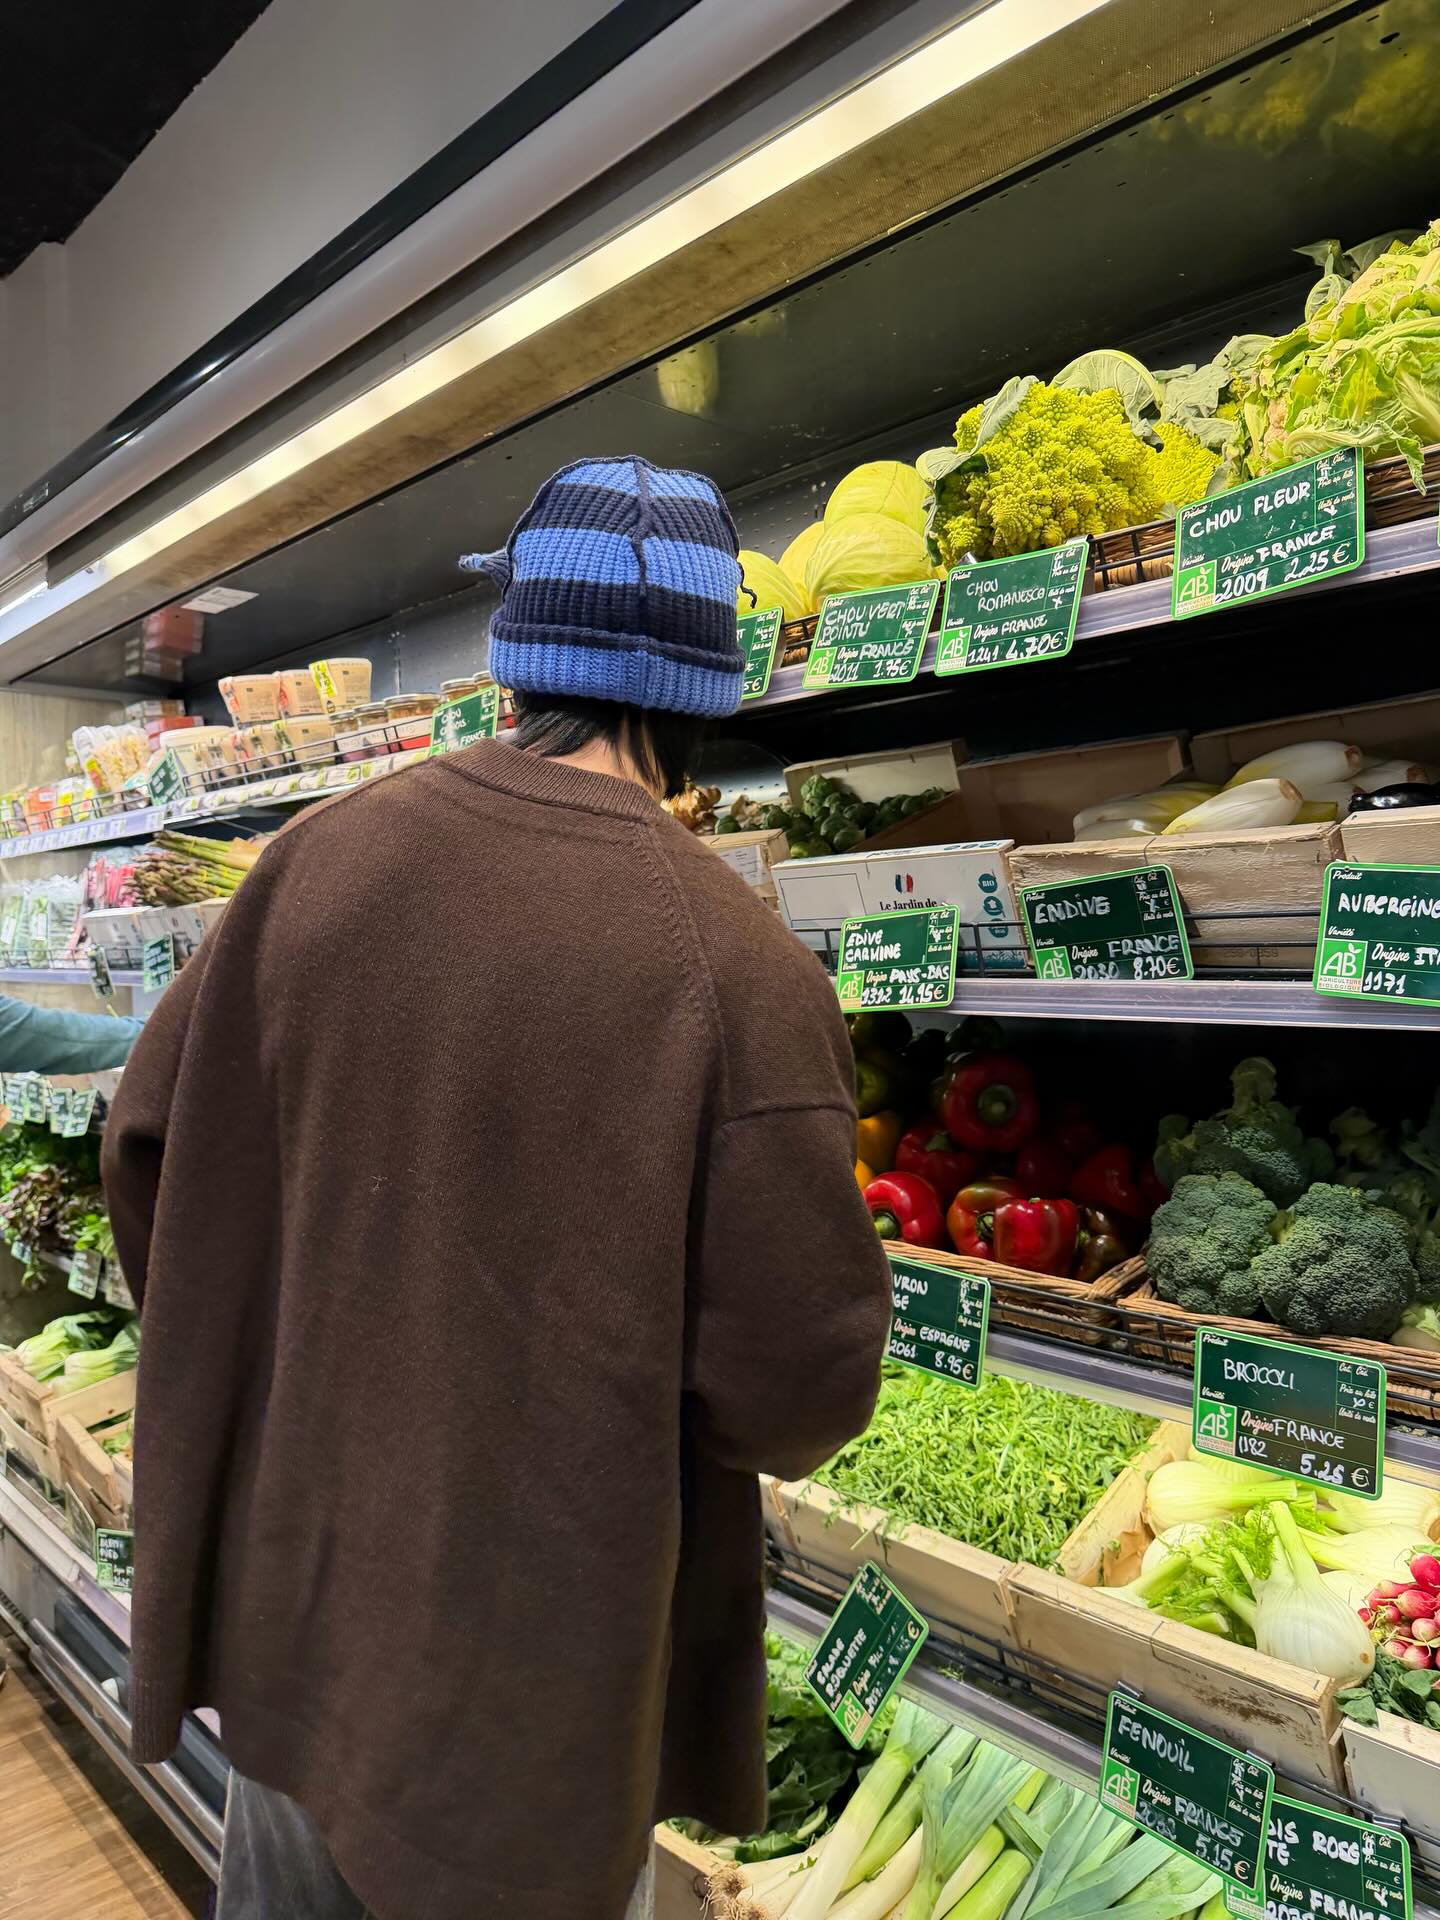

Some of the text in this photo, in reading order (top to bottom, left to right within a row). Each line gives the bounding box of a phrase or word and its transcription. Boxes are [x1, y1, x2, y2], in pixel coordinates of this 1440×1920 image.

[1189, 481, 1311, 537] CHOU FLEUR
[1221, 524, 1337, 574] Origine FRANCE
[966, 578, 998, 596] CHOU
[1179, 575, 1209, 602] AB
[1214, 568, 1269, 604] 2009
[978, 587, 1046, 612] ROMANESCO
[825, 605, 866, 625] CHOU
[869, 601, 905, 620] VERT
[822, 621, 870, 642] POINTU
[974, 614, 1047, 642] Origine FRANCE
[859, 638, 915, 660] FRANCE
[941, 637, 964, 659] AB
[968, 645, 999, 664] 1241
[809, 656, 829, 675] AB
[1332, 870, 1363, 880] Produit
[880, 899, 938, 911] Le Jardin de
[1034, 894, 1111, 925] ENDIVE
[1338, 892, 1440, 919] AUBERGINE
[1328, 926, 1355, 937] Variété
[845, 942, 901, 963] CARMINE
[1071, 934, 1180, 964] Origine FRANCE
[1371, 943, 1410, 968] Origine
[1042, 958, 1066, 978] AB
[1323, 952, 1357, 976] AB
[840, 980, 859, 999] AB
[1223, 1359, 1294, 1390] BROCOLI
[1200, 1413, 1229, 1438] AB
[1241, 1410, 1345, 1449] Origine FRANCE
[1239, 1435, 1268, 1458] 1182
[843, 1704, 861, 1734] AB
[1117, 1715, 1194, 1774] FENOUIL
[1106, 1774, 1132, 1800] AB
[1142, 1779, 1172, 1808] Origine
[1174, 1796, 1246, 1847] FRANCE
[1270, 1874, 1304, 1902] Origine
